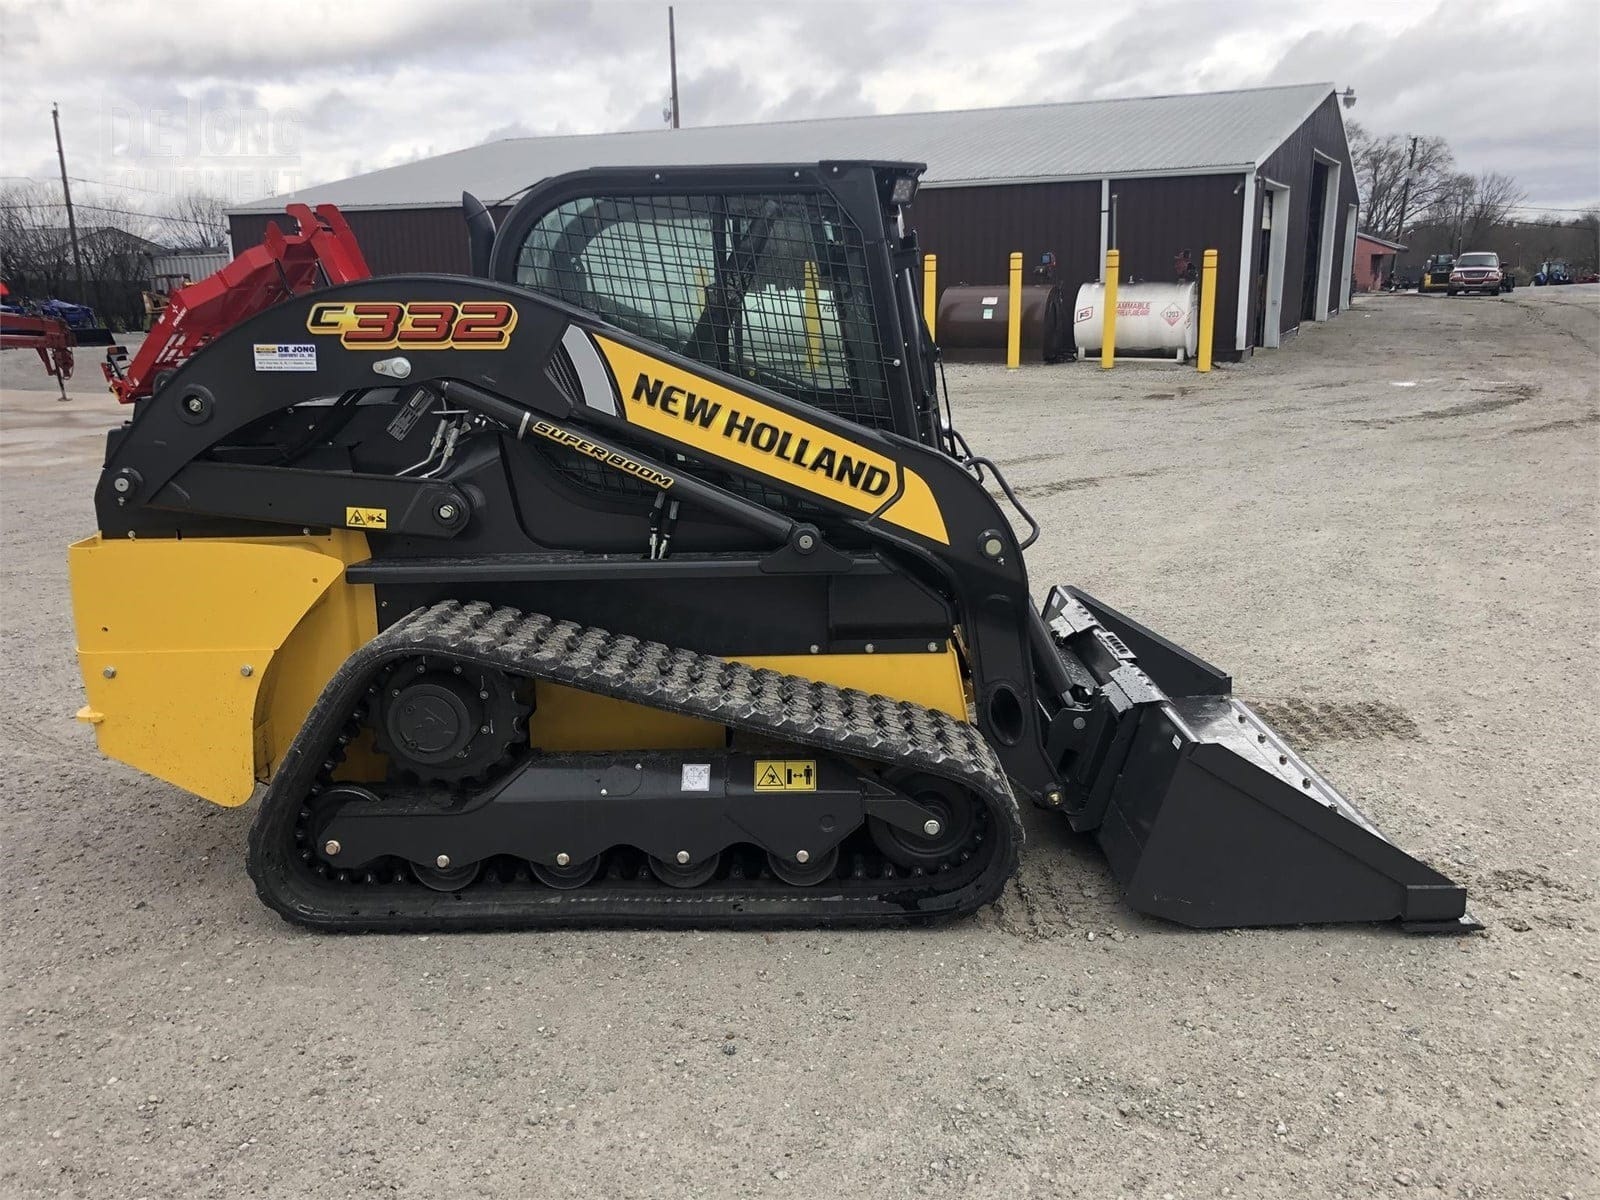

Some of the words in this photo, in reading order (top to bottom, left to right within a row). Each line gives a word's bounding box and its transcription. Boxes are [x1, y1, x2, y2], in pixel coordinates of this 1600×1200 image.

[308, 303, 517, 348] C332
[534, 422, 608, 459] SUPER
[608, 453, 673, 488] BOOM
[631, 372, 721, 429] NEW
[723, 410, 891, 497] HOLLAND
